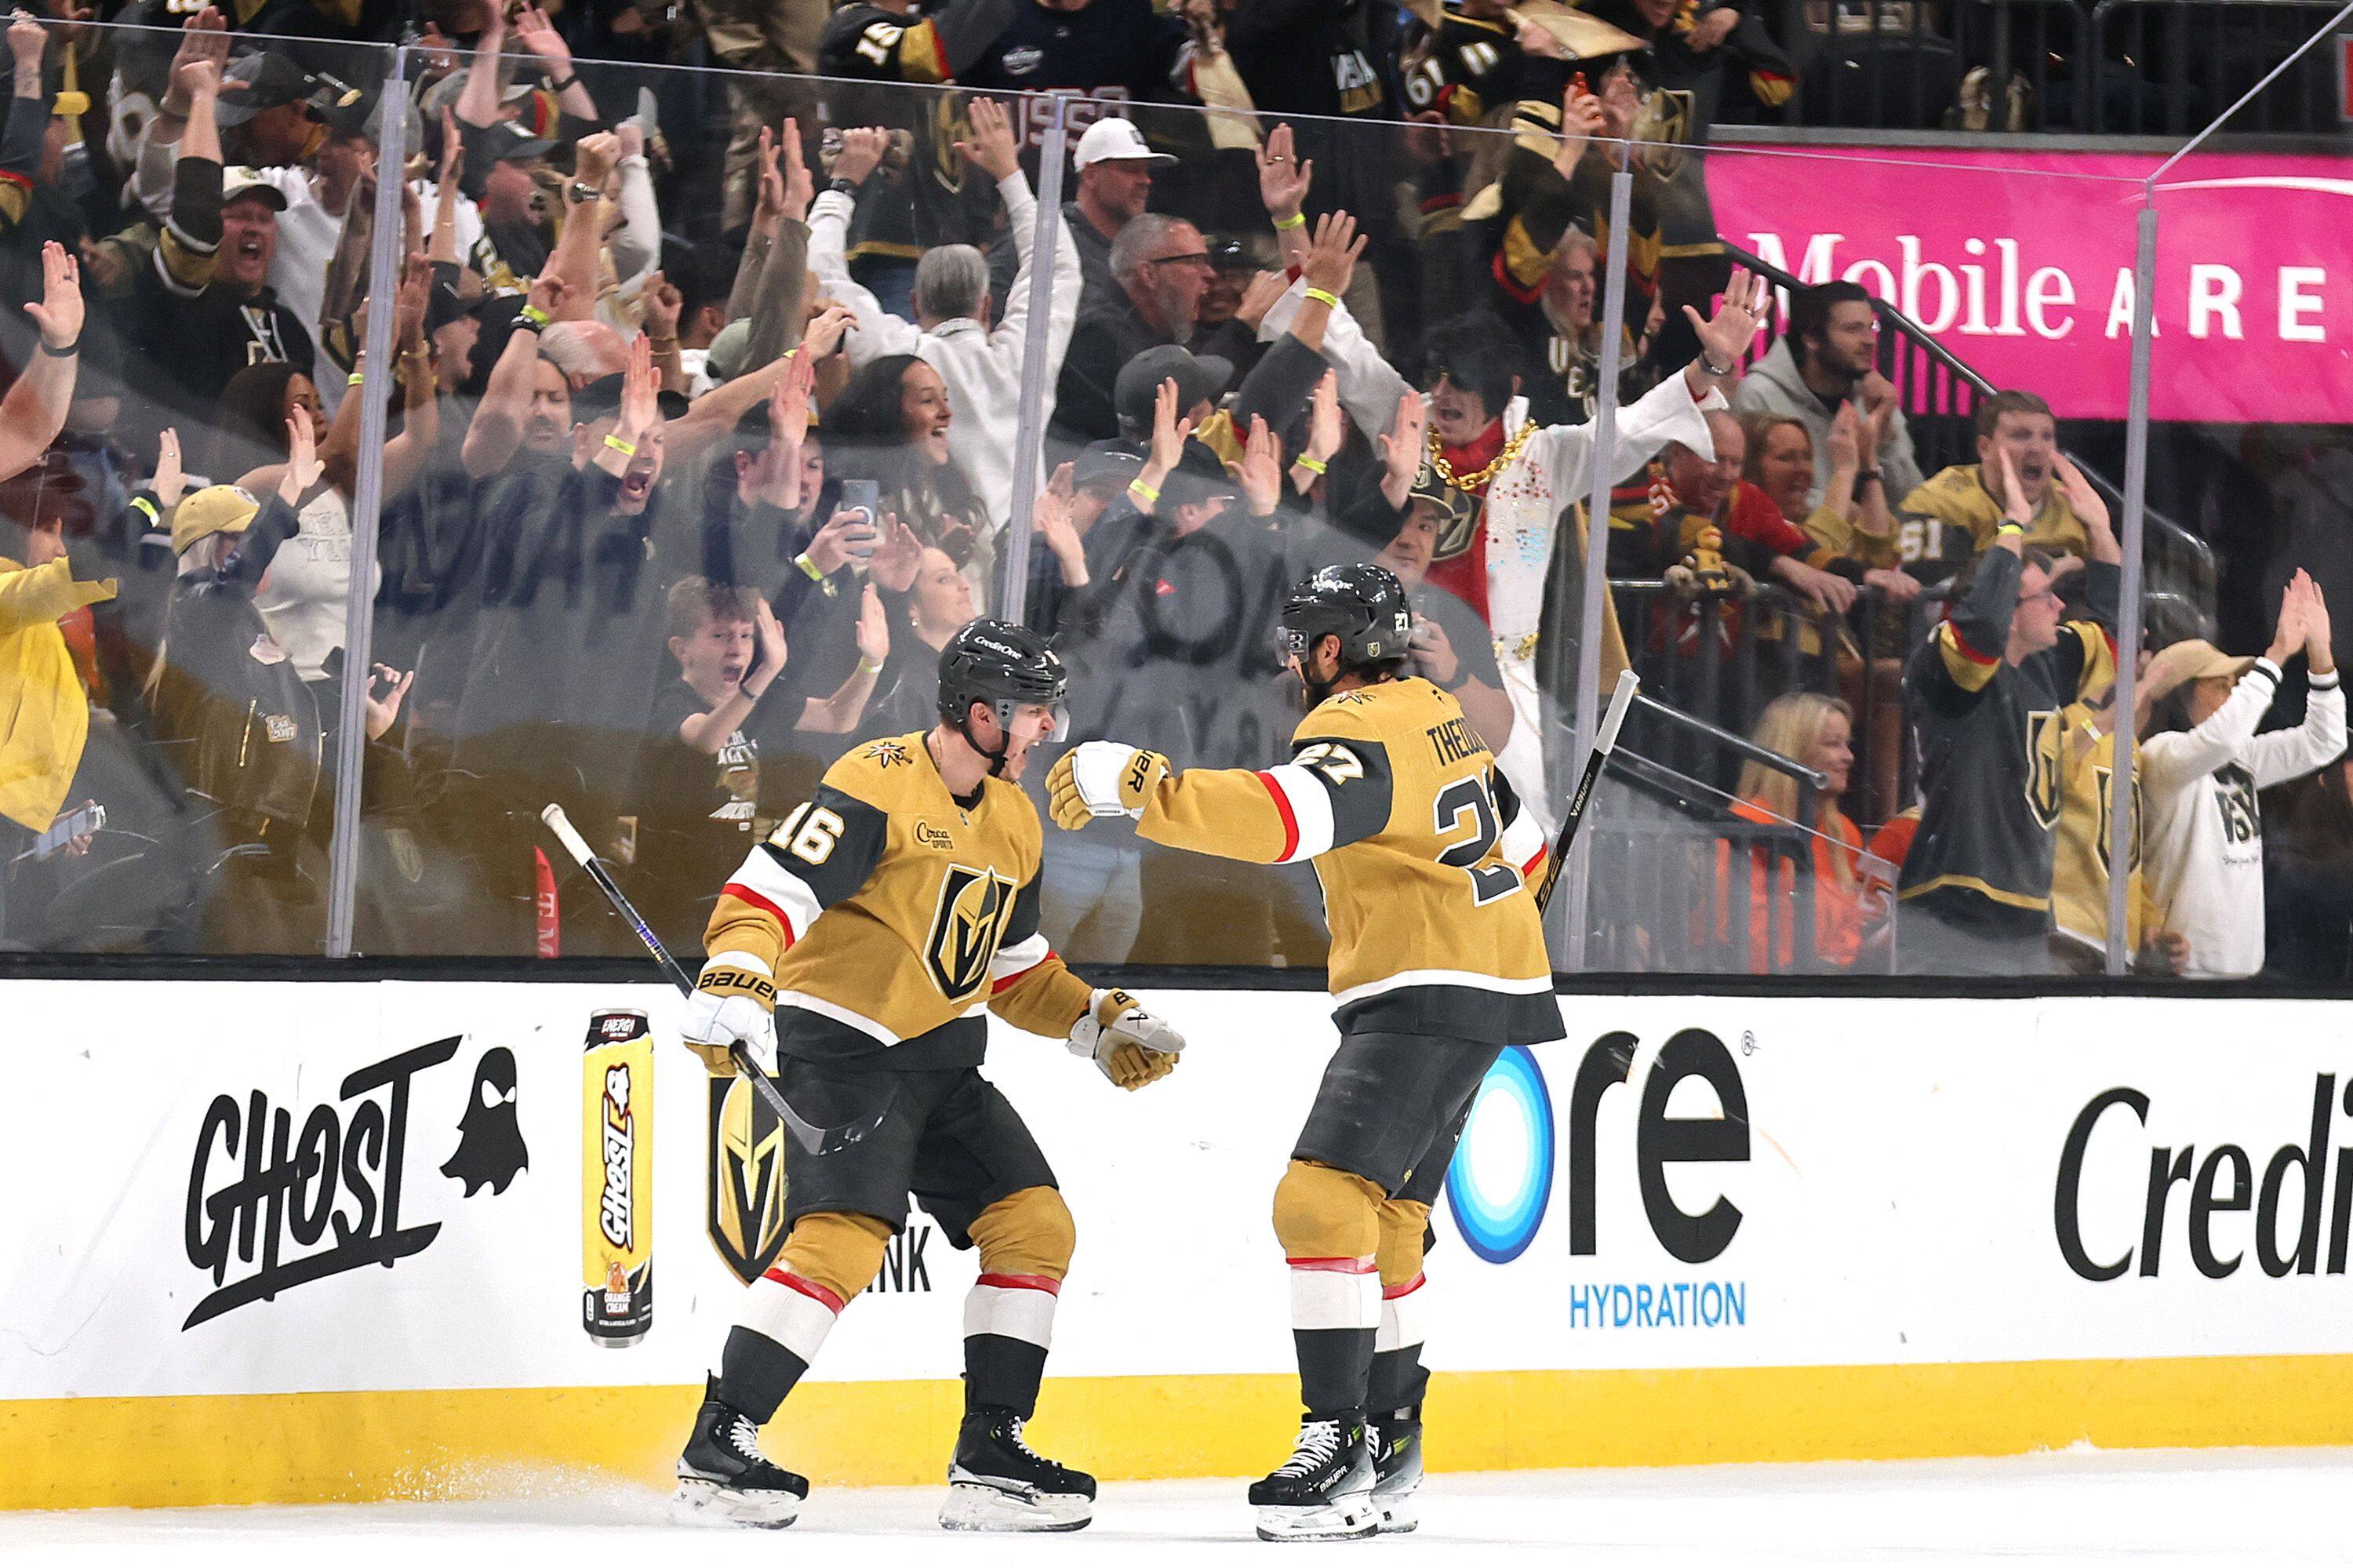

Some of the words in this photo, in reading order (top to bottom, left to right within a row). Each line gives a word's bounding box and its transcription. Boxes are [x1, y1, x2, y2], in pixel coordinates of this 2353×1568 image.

[974, 635, 1022, 660] CreditOne
[768, 802, 846, 865] 16
[916, 821, 949, 843] Circa
[932, 839, 954, 849] SPORTS
[1423, 1028, 1751, 1264] ore
[182, 1035, 463, 1332] GHOST
[600, 1095, 634, 1253] GHOST
[604, 1292, 632, 1303] ORANGE
[606, 1303, 629, 1314] CREAM
[1569, 1281, 1746, 1328] HYDRATION
[1319, 1464, 1349, 1493] BAUER
